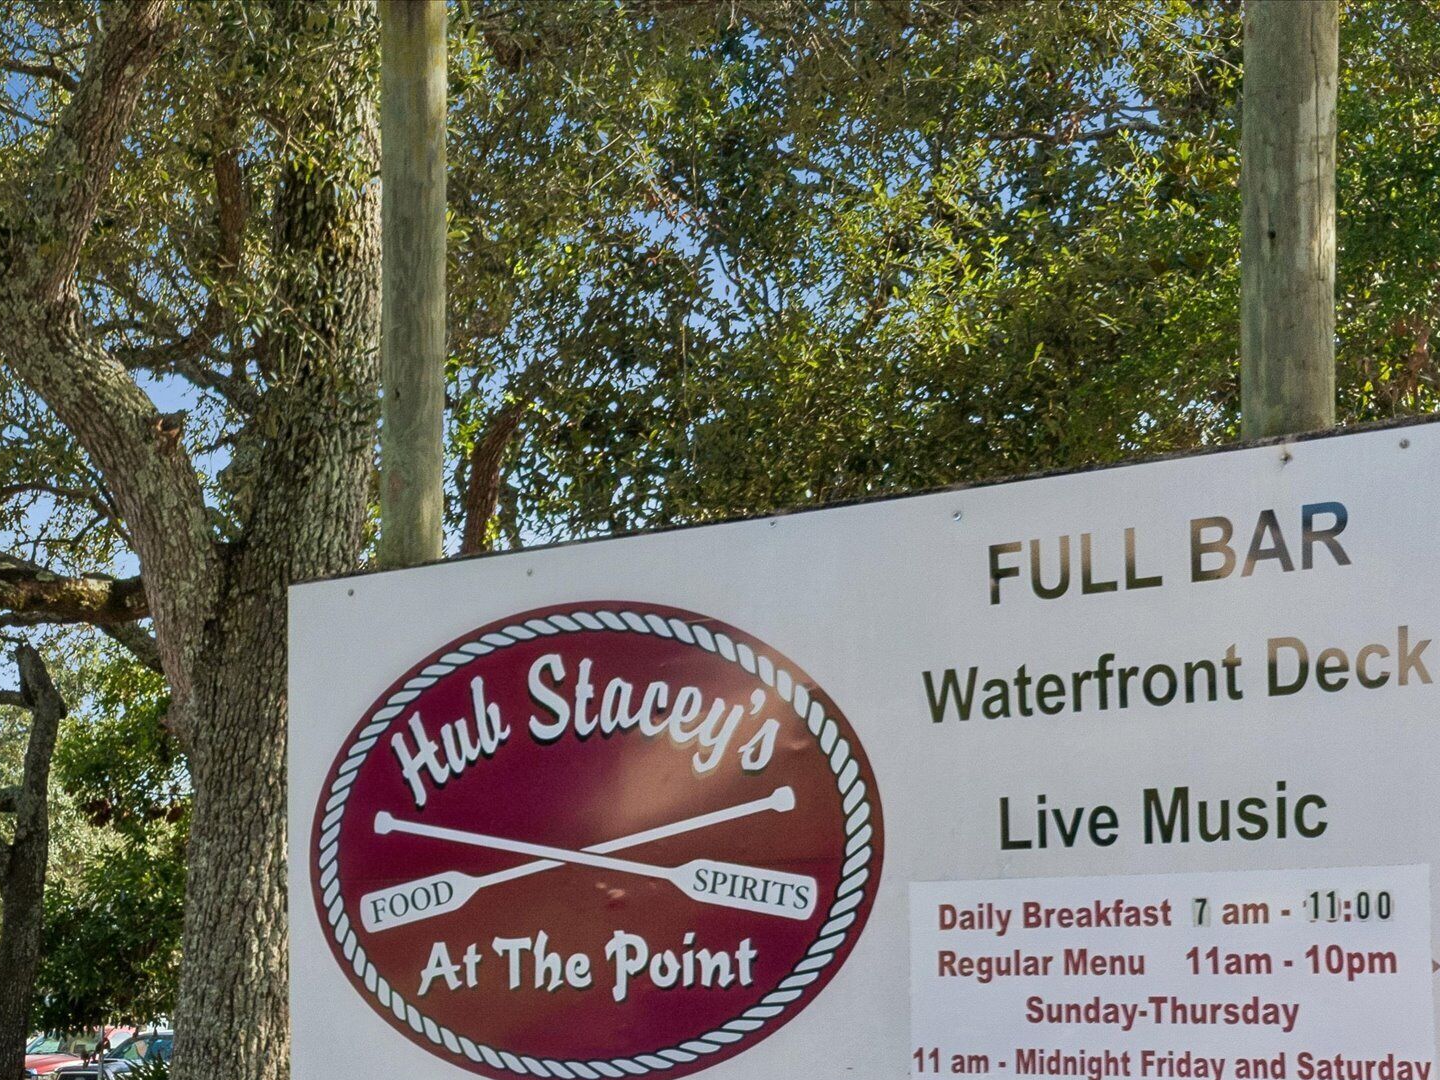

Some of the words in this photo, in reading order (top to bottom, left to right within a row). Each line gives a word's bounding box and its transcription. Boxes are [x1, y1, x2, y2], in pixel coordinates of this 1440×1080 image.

[988, 527, 1163, 605] FULL
[1189, 501, 1352, 583] BAR
[922, 643, 1243, 724] Waterfront
[1266, 625, 1434, 697] Deck
[391, 676, 511, 807] Hub
[528, 654, 781, 773] Stacey's
[999, 794, 1119, 851] Live
[1143, 781, 1328, 845] Music
[370, 879, 454, 924] FOOD
[692, 867, 810, 910] SPIRITS
[938, 901, 1012, 935] Daily
[1022, 899, 1172, 930] Breakfast
[1193, 897, 1207, 926] 7
[1221, 902, 1270, 926] am
[1309, 890, 1391, 922] 11:00
[417, 941, 482, 996] At
[492, 930, 592, 991] The
[605, 930, 758, 1002] Point
[938, 949, 1053, 984] Regular
[1063, 948, 1146, 977] Menu
[1186, 946, 1273, 976] 11am
[1305, 944, 1398, 982] 10pm
[1025, 996, 1300, 1031] Sunday-Thursday
[913, 1047, 940, 1074] 11
[951, 1054, 989, 1075] am
[1235, 1053, 1286, 1080] and
